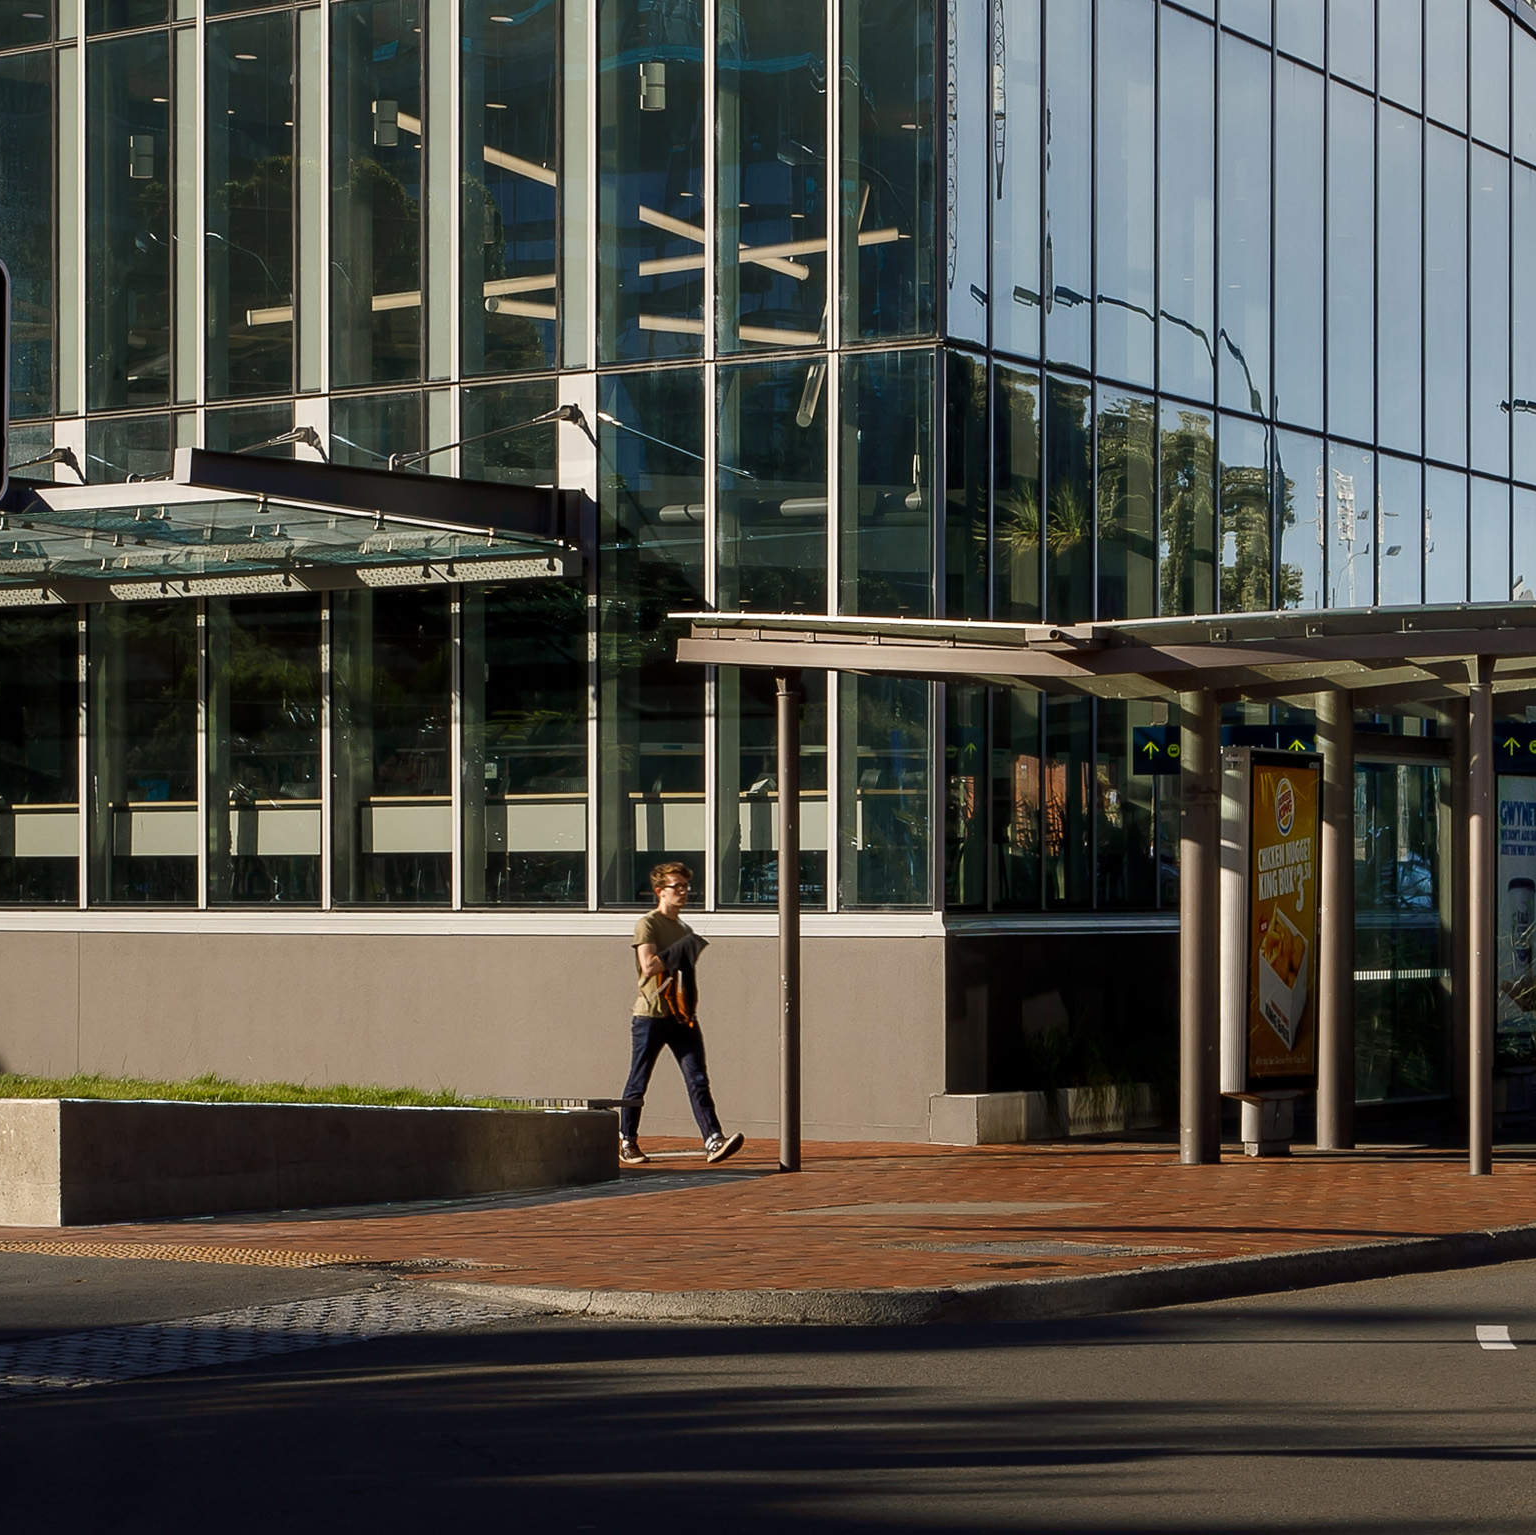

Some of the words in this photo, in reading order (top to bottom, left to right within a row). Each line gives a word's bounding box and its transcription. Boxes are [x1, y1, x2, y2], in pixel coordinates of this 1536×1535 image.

[1258, 844, 1285, 872] CHICKEN
[1286, 837, 1311, 865] NUGGET
[1258, 869, 1278, 901] KING
[1278, 865, 1295, 896] BOX
